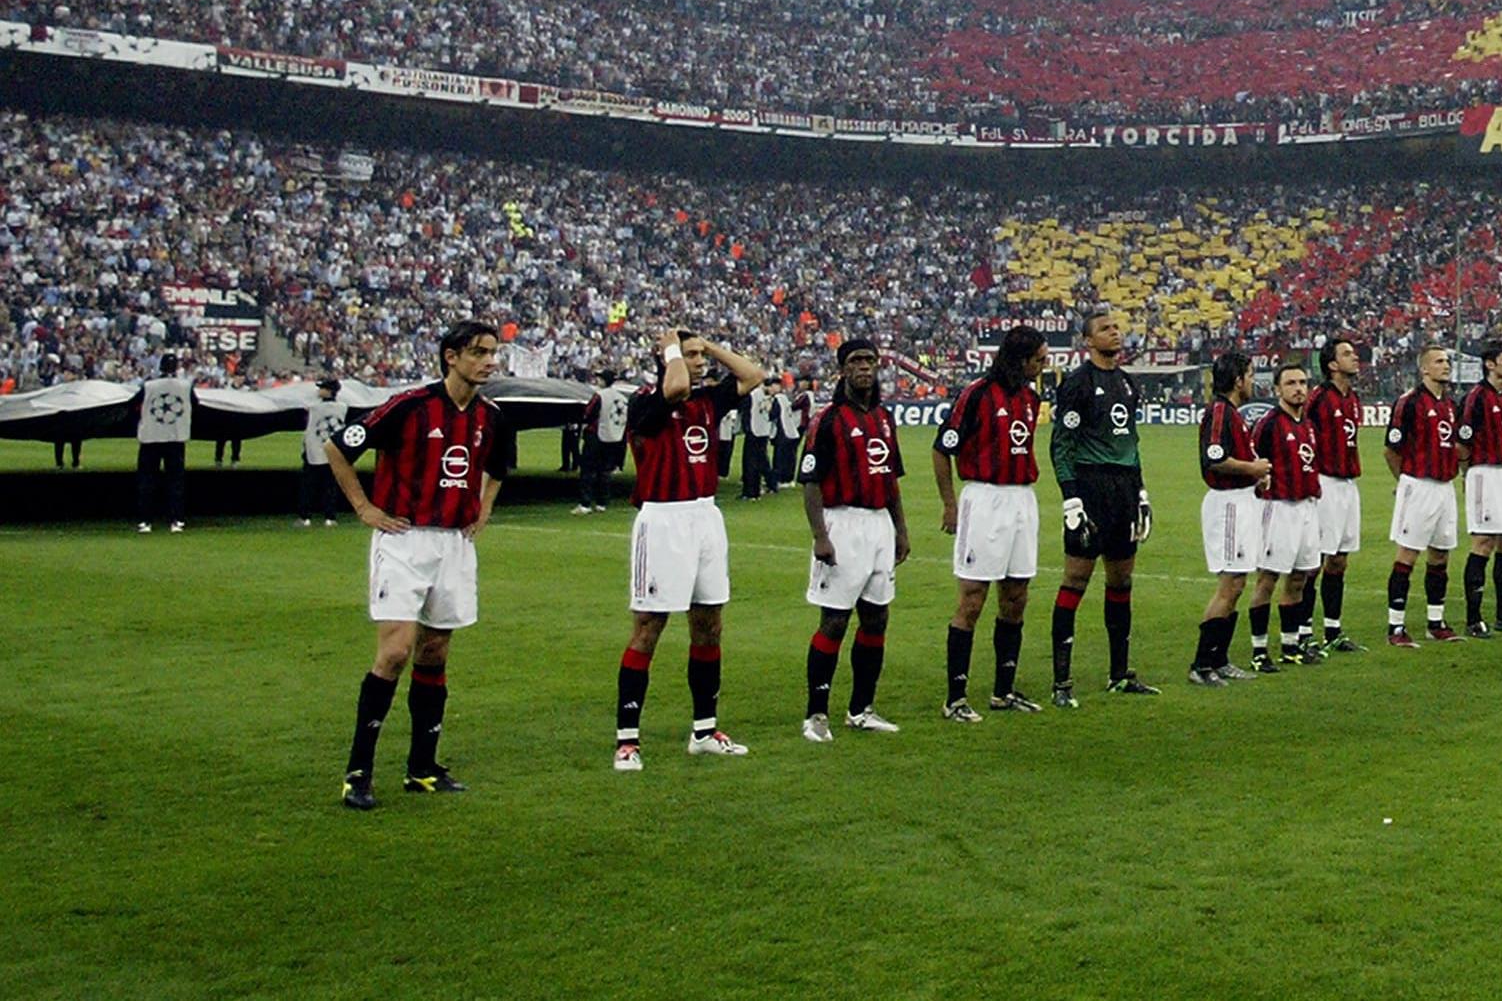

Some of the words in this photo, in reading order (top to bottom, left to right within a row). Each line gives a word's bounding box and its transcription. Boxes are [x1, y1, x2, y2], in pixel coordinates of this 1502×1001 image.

[229, 53, 337, 77] VALLESUSA
[657, 101, 709, 118] SARONNO
[1104, 126, 1238, 145] TORCIDA
[440, 479, 468, 489] OPEL
